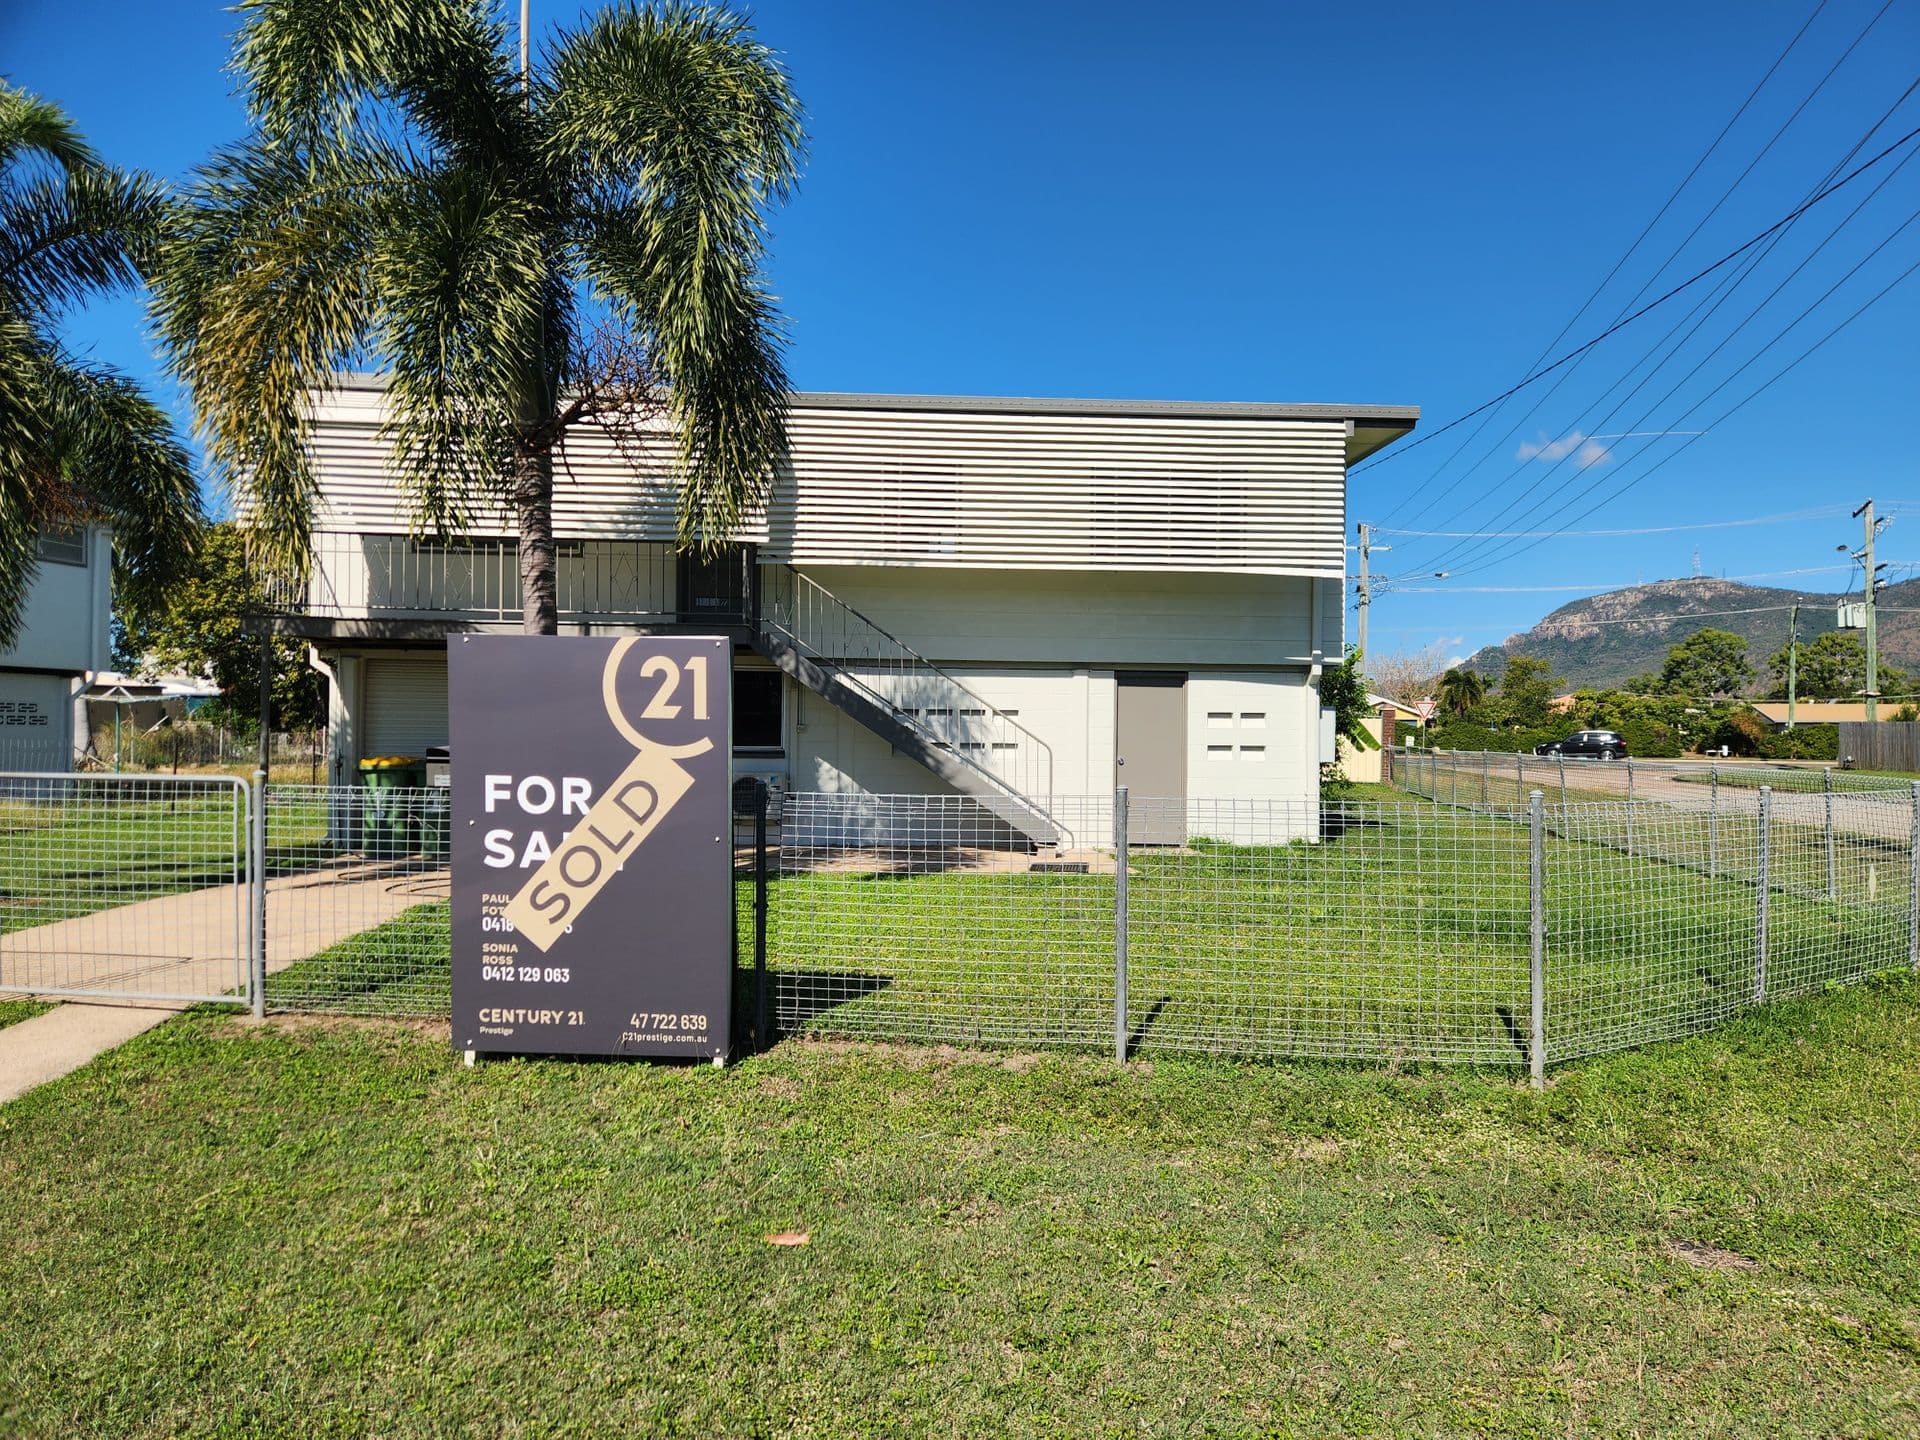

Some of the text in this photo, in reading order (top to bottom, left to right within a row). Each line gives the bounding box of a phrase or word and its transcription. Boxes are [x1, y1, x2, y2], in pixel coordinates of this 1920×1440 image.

[640, 655, 707, 720] 21
[484, 774, 593, 816] FOR
[529, 780, 659, 925] SOLD
[481, 893, 511, 905] PAUL
[481, 943, 518, 953] SONIA
[481, 955, 514, 965] ROSS
[482, 966, 570, 983] 0412 129 063
[478, 1008, 563, 1024] CENTURY
[630, 1013, 707, 1031] 47 722 639
[479, 1026, 514, 1036] Prestige
